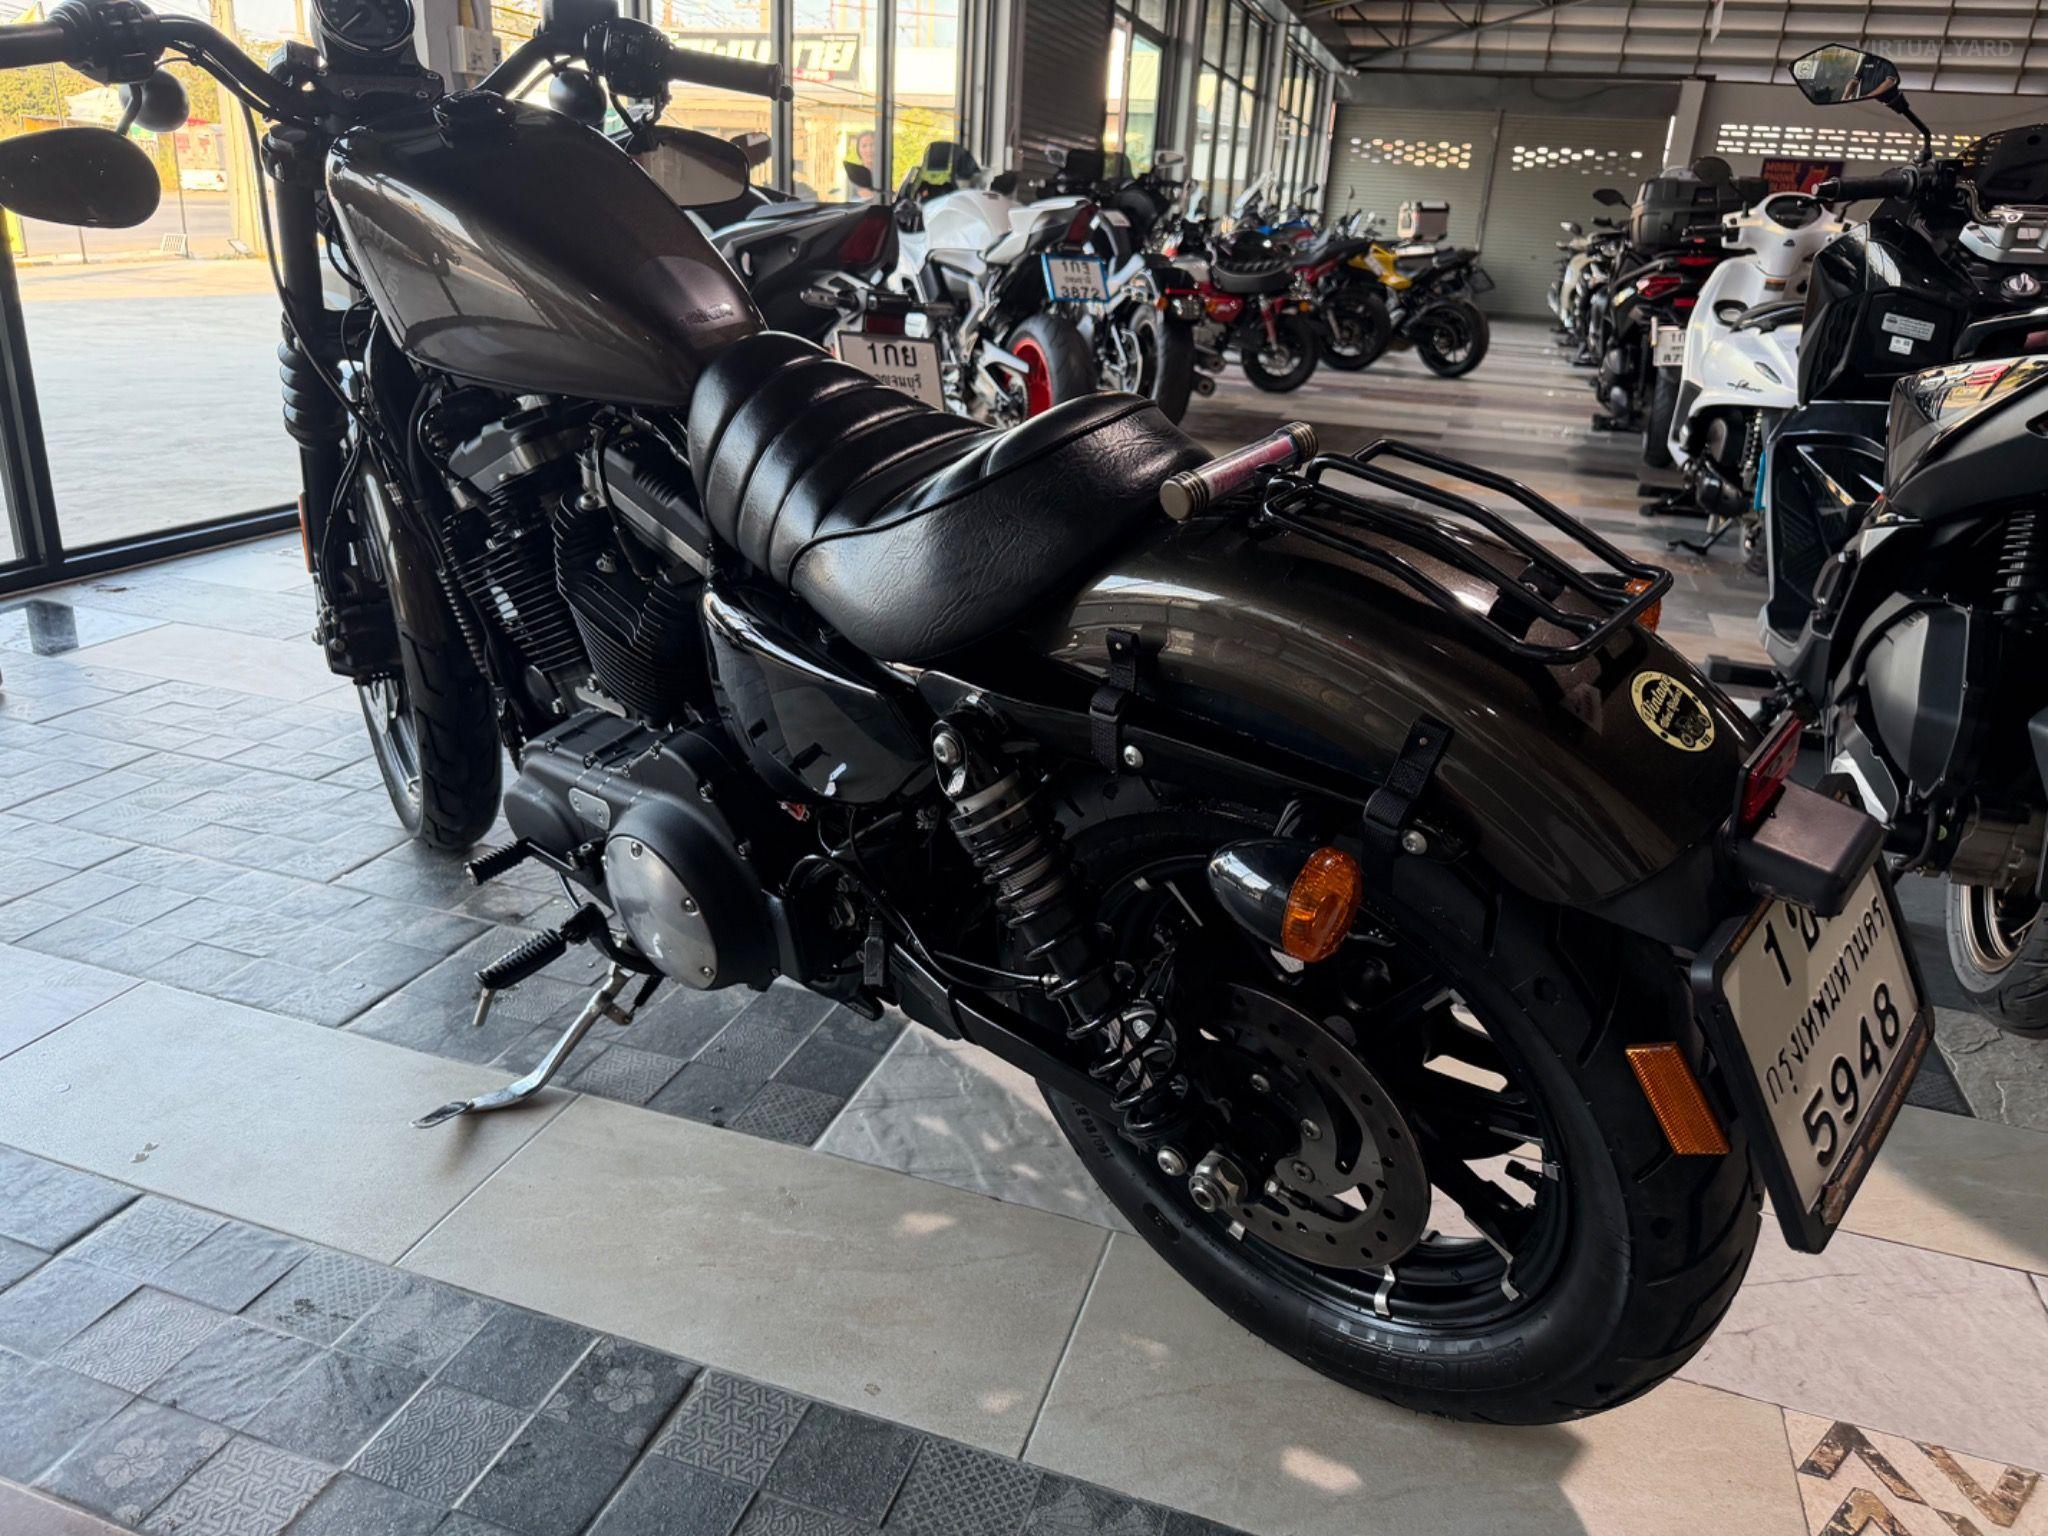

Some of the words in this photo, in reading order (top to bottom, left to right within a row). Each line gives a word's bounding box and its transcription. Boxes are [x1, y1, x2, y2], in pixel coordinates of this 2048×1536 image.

[867, 342, 918, 367] 1กย
[1766, 896, 1886, 1104] กรุงเทพมหานคร
[1803, 982, 1900, 1167] 5948
